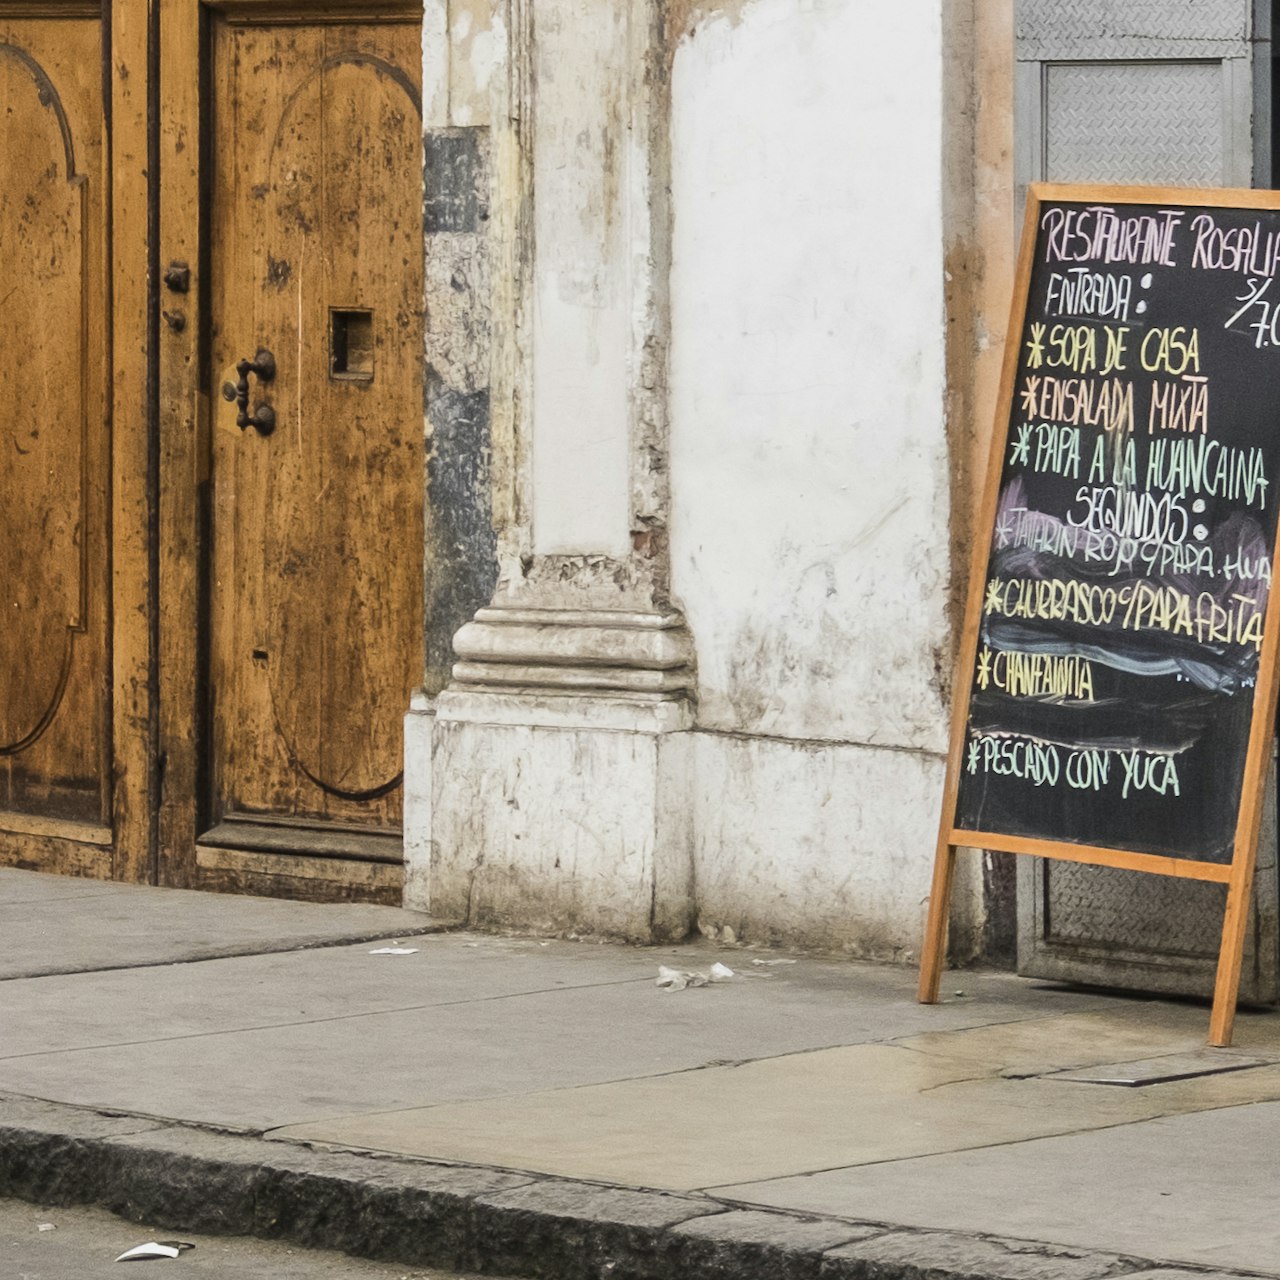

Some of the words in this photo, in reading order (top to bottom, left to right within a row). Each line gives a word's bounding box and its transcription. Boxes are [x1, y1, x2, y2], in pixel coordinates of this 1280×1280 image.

[1043, 206, 1184, 267] RESTAURANTE
[1100, 326, 1130, 376] DE
[1141, 326, 1200, 375] CASA
[1148, 375, 1209, 435] MIXTA
[1088, 434, 1105, 483] A
[1146, 435, 1269, 510] HUANCAINA
[1066, 749, 1109, 791] CON
[1121, 752, 1180, 799] YUCA
